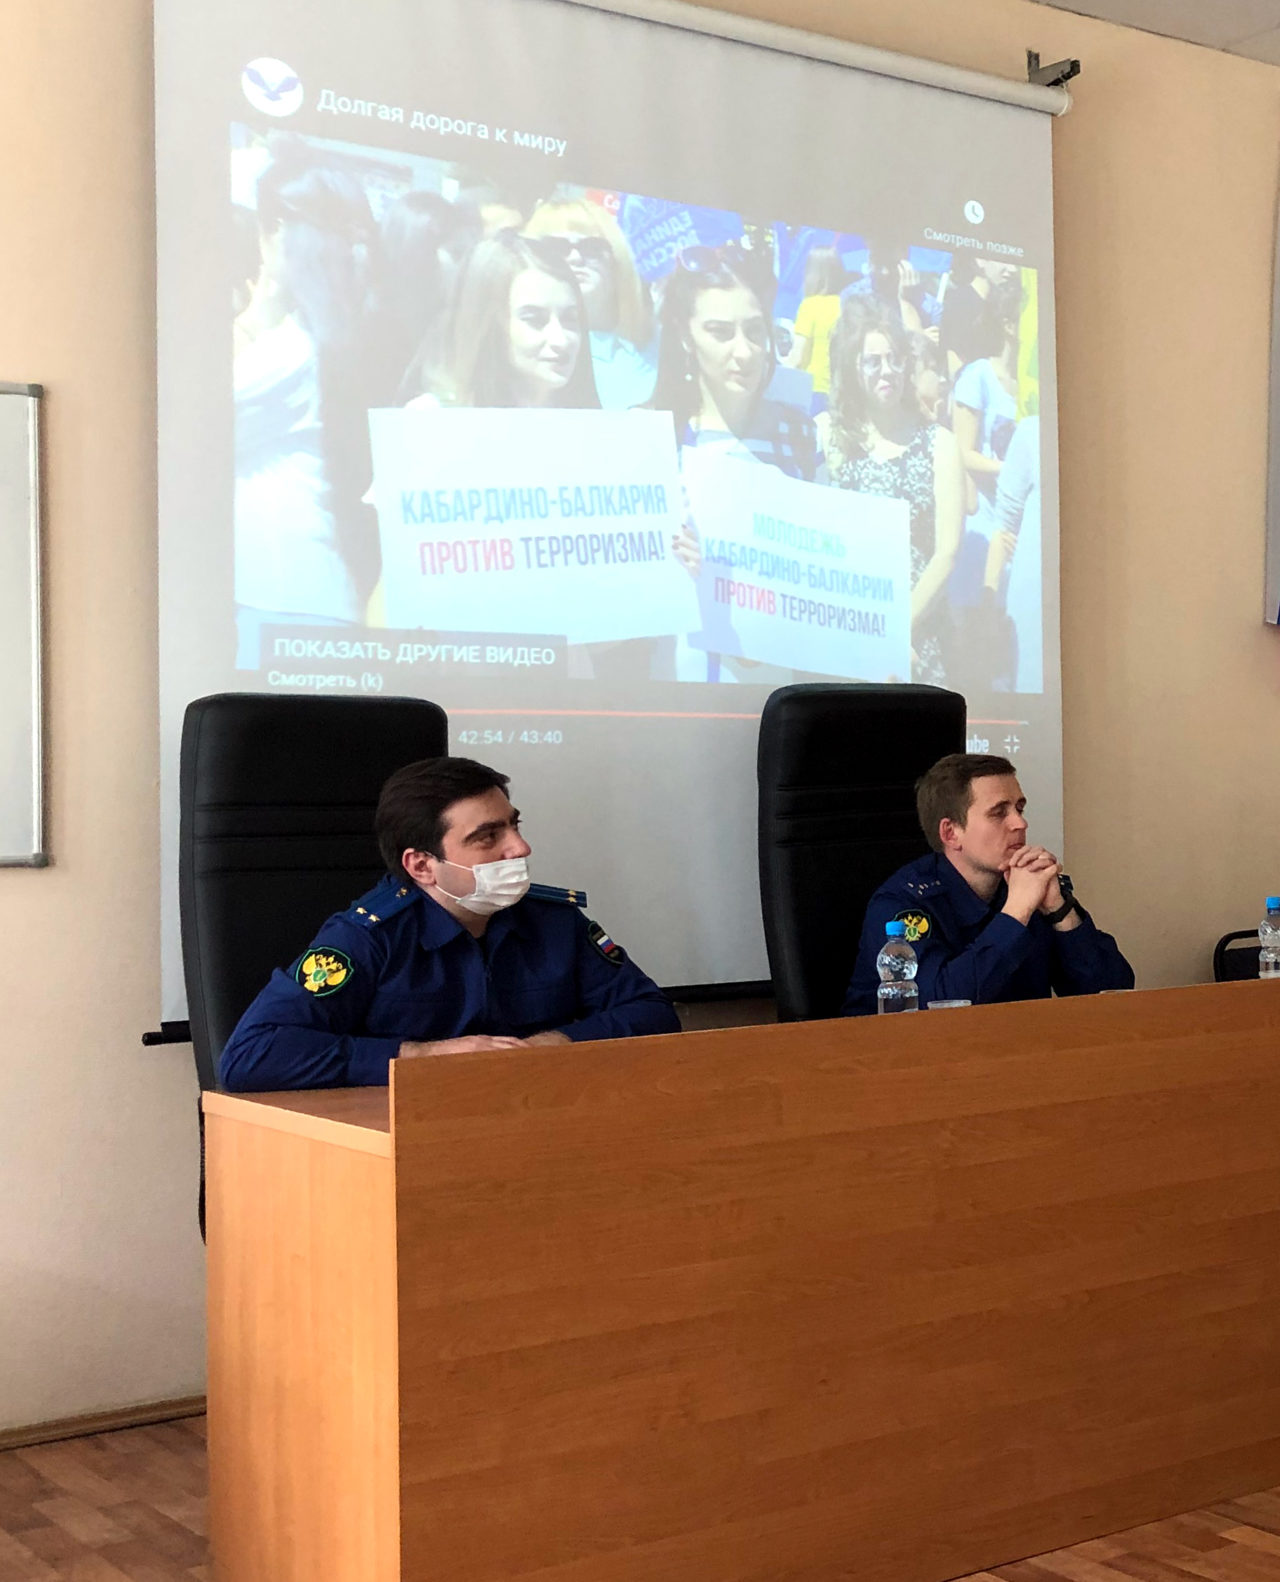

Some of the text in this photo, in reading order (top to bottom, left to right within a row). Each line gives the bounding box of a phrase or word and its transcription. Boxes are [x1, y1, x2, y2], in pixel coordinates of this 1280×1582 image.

[317, 89, 568, 157] Долгая дорога к миру
[923, 227, 1025, 257] Смотреть позже
[402, 484, 668, 524] КАБАРДИНО-БАЛКАРИЯ
[419, 530, 666, 575] ПРОТИВ ТЕРРОРИЗМА!
[704, 537, 894, 602] КАБАРДИНО-БАЛКАРИИ
[714, 577, 886, 638] ПРОТИВ ТЕРРОРИЗМА!
[274, 638, 555, 667] ПОКАЗАТЬ ДРУГИЕ ВИДЕО
[268, 671, 356, 690] Смотреть
[458, 730, 503, 745] 42:54
[519, 730, 563, 745] 43:40
